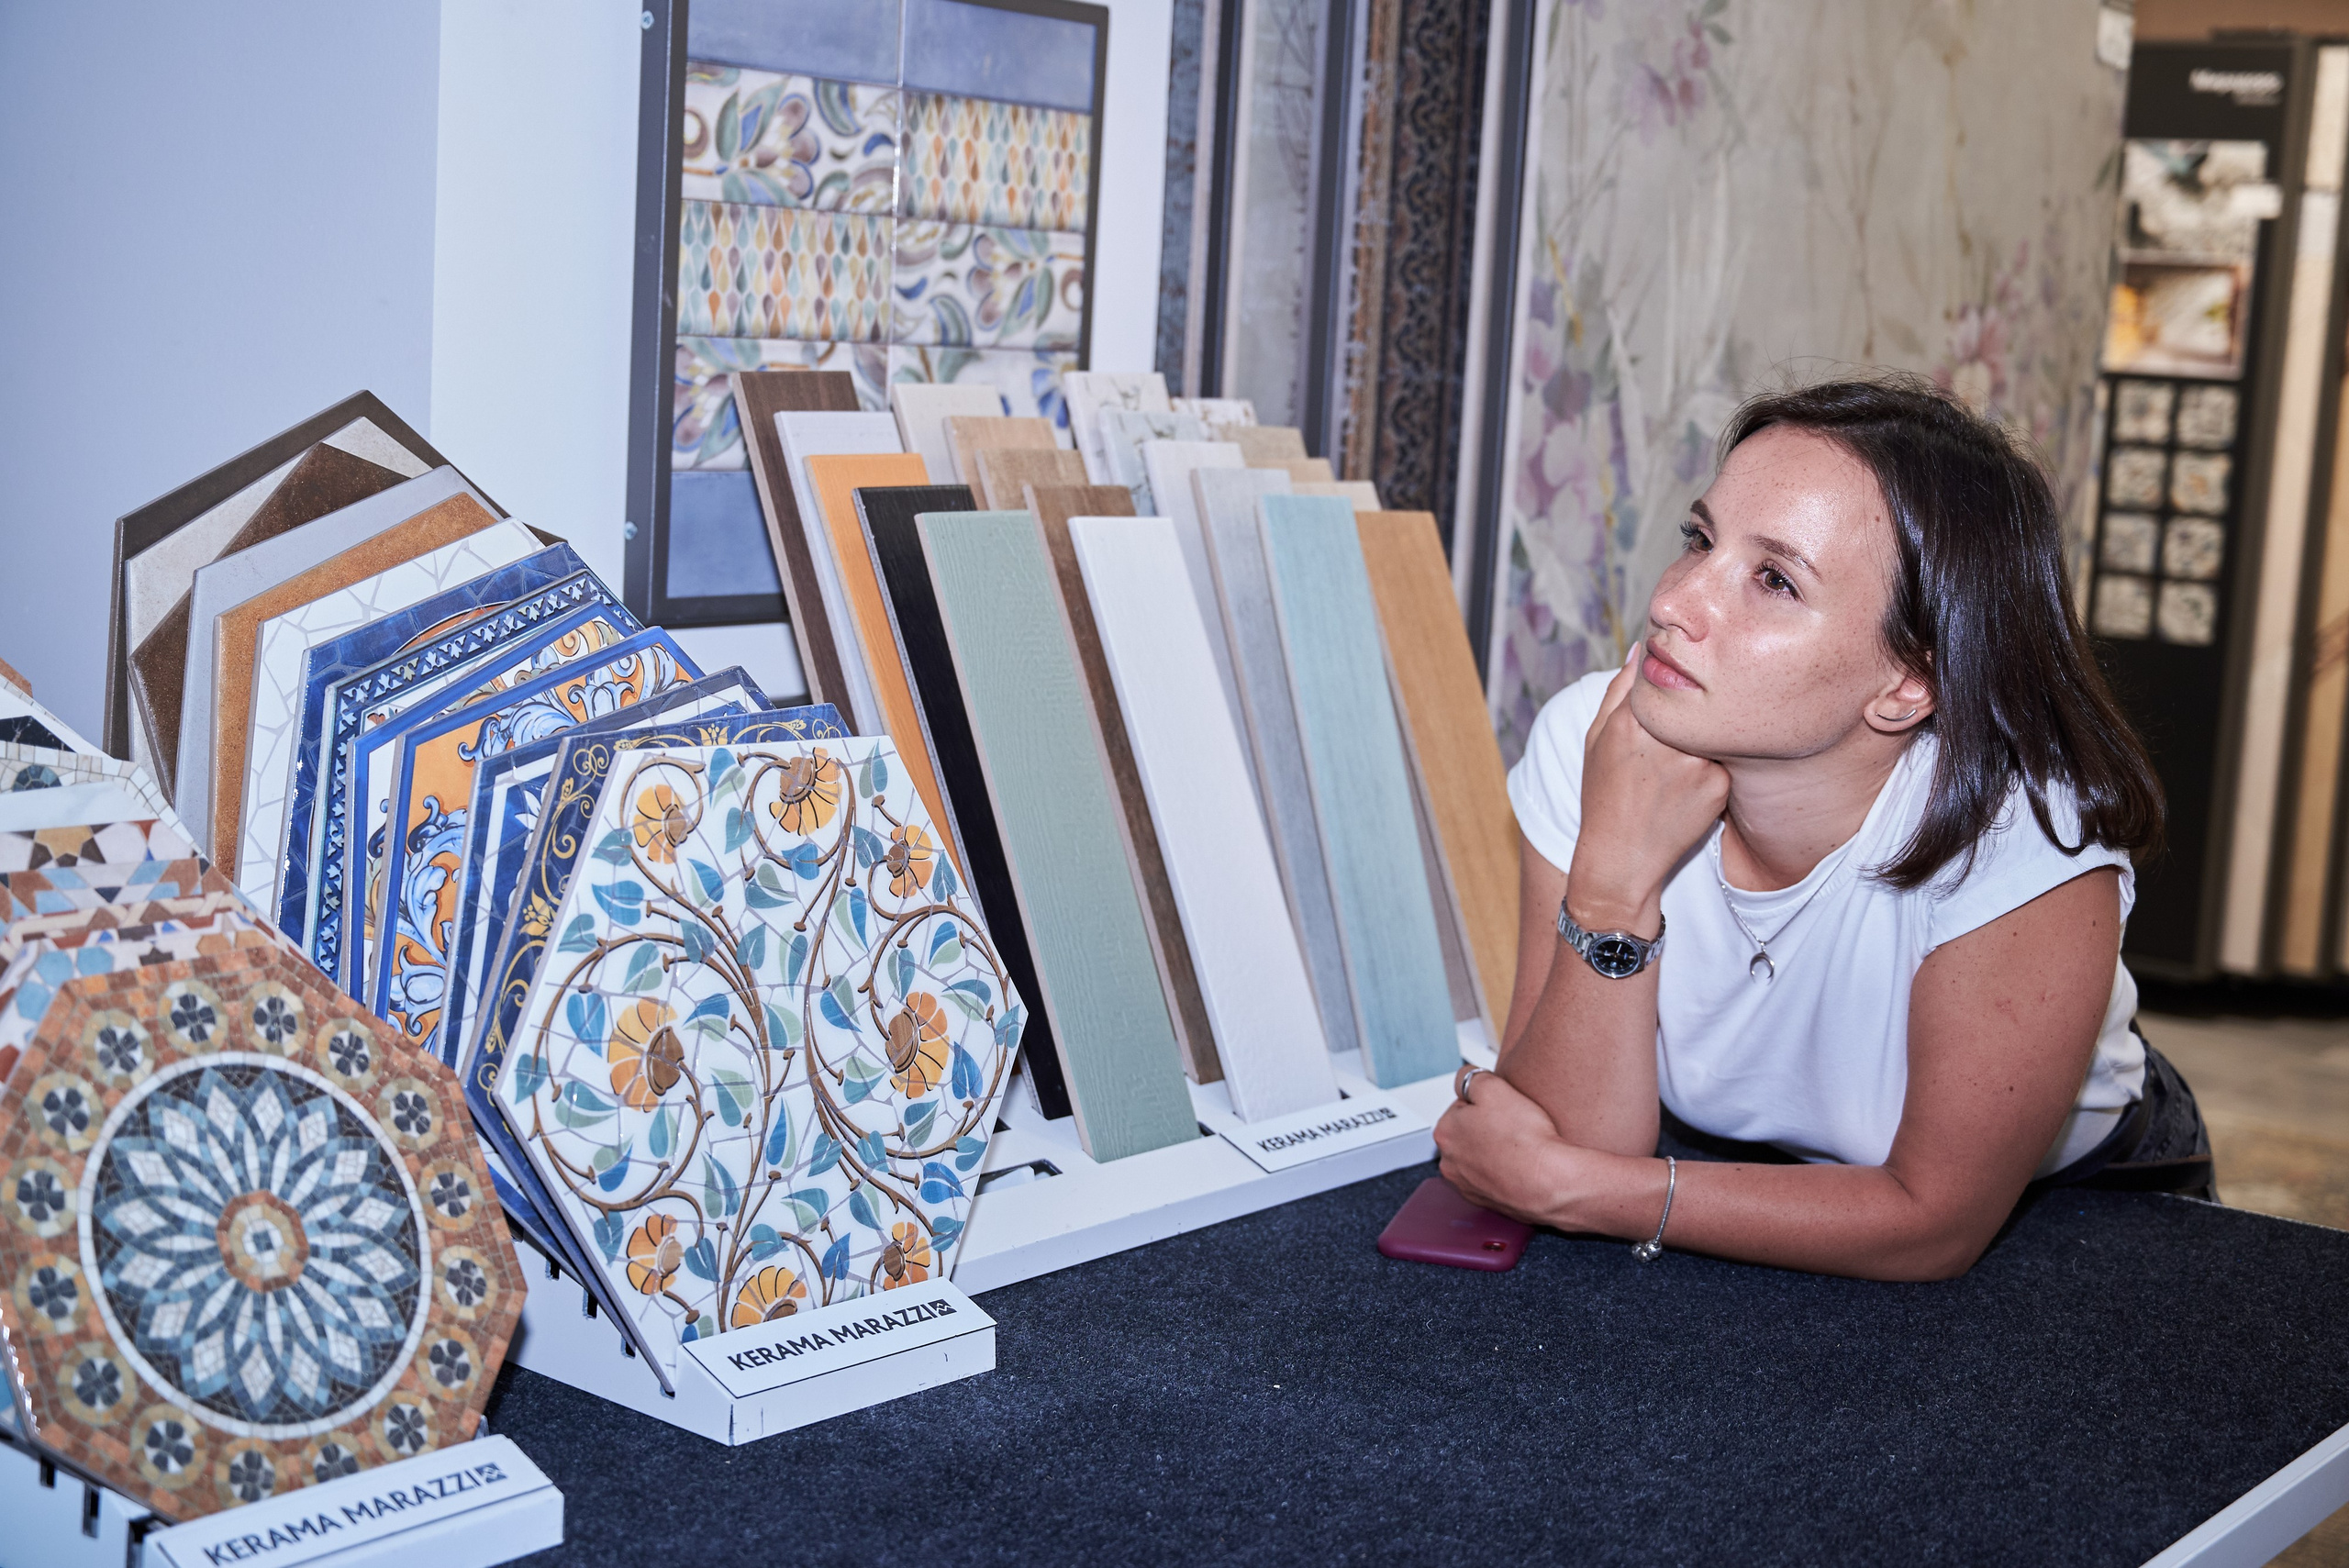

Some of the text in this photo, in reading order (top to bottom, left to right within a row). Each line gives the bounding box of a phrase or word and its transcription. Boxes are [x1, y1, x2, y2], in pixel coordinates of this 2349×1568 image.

[1257, 1109, 1384, 1152] KERAMA MARAZZI
[728, 1303, 938, 1371] KERAMA MARAZZI
[204, 1469, 481, 1567] KERAMA MARAZZI
